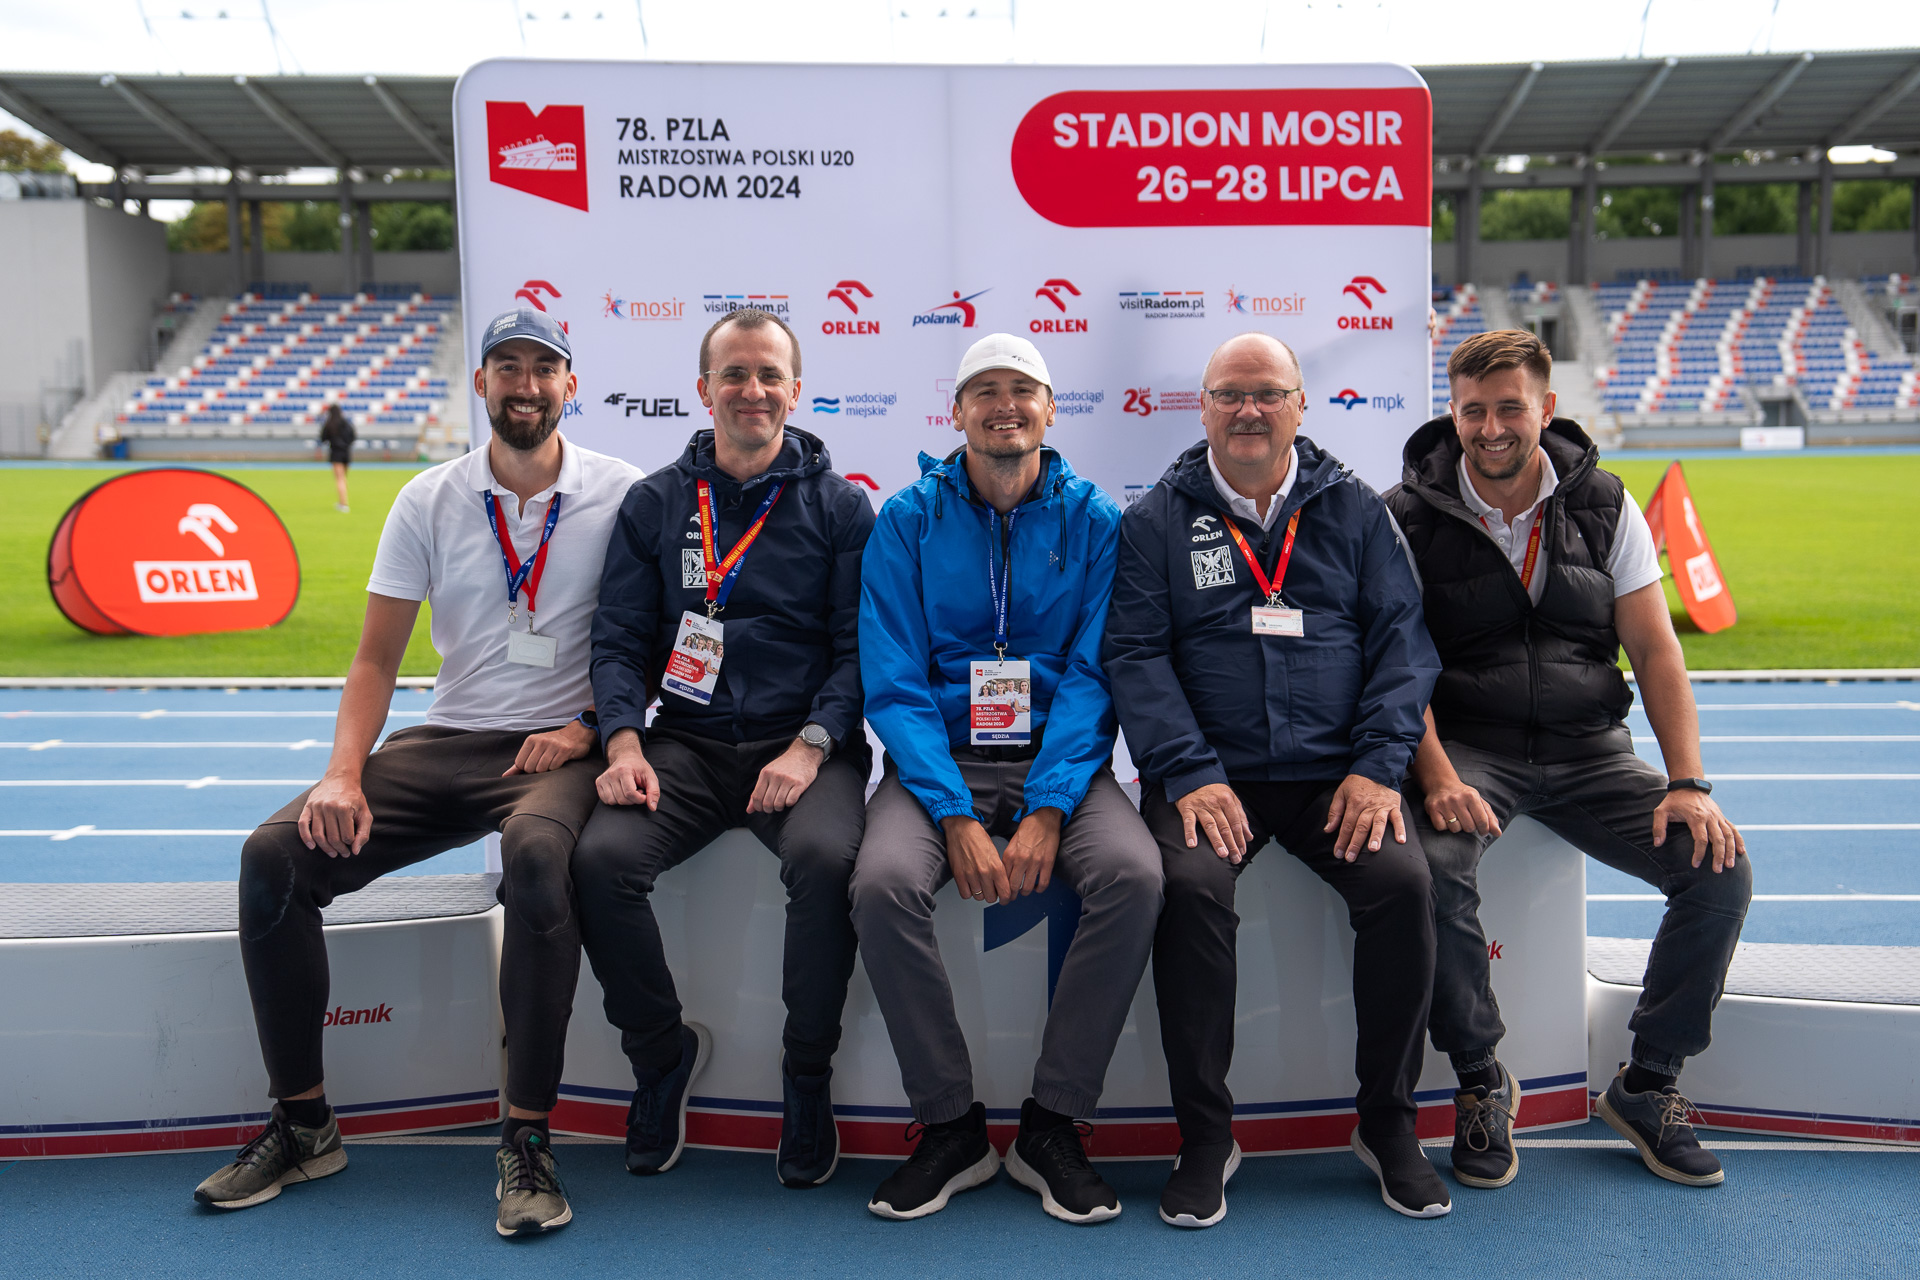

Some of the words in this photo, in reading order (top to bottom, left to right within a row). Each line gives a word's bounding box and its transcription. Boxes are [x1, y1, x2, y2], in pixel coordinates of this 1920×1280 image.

[617, 118, 656, 141] 78.
[666, 119, 730, 141] PZLA
[1053, 112, 1250, 148] STADION
[1262, 110, 1403, 147] MOSIR
[618, 149, 746, 166] MISTRZOSTWA
[752, 150, 815, 167] POLSKI
[820, 151, 855, 167] U20
[619, 175, 728, 198] RADOM
[736, 176, 801, 198] 2024
[1279, 166, 1404, 201] LIPCA
[631, 297, 686, 317] mosir
[1120, 297, 1205, 310] visitRadom.pl
[1253, 292, 1307, 312] mosir
[822, 321, 880, 335] ORLEN
[912, 312, 962, 327] polanik
[1029, 319, 1088, 333] ORLEN
[1337, 316, 1393, 330] ORLEN
[845, 392, 897, 405] wodociągi
[1053, 390, 1104, 403] wodociągi
[1373, 393, 1405, 413] mpk
[564, 401, 583, 419] pk
[626, 399, 689, 417] FUEL
[845, 405, 887, 418] miejskie
[1192, 530, 1223, 542] ORLEN
[724, 549, 741, 569] CENTRALNE
[737, 534, 753, 552] KOLEGIUM
[146, 569, 248, 594] ORLEN
[1197, 571, 1232, 586] PZLA
[323, 1002, 394, 1027] olanik
